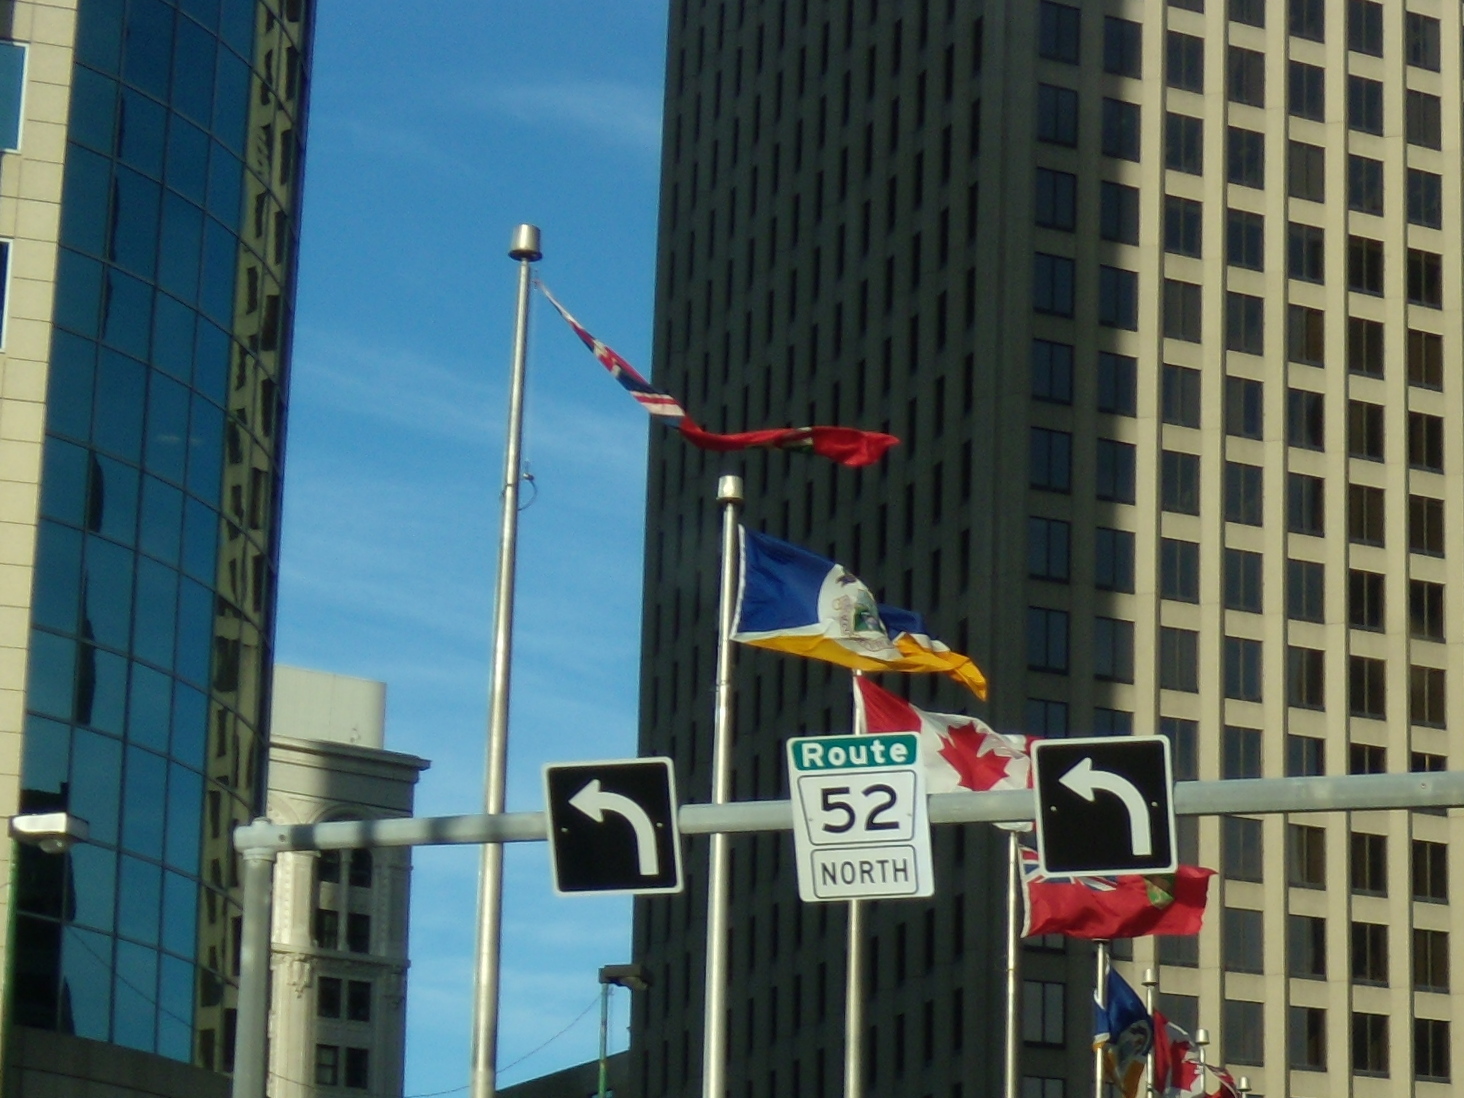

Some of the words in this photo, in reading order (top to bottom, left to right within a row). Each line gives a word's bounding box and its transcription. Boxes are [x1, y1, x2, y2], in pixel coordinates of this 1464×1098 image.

[801, 739, 909, 768] Route
[821, 783, 900, 834] 52
[820, 858, 909, 886] NORTH
